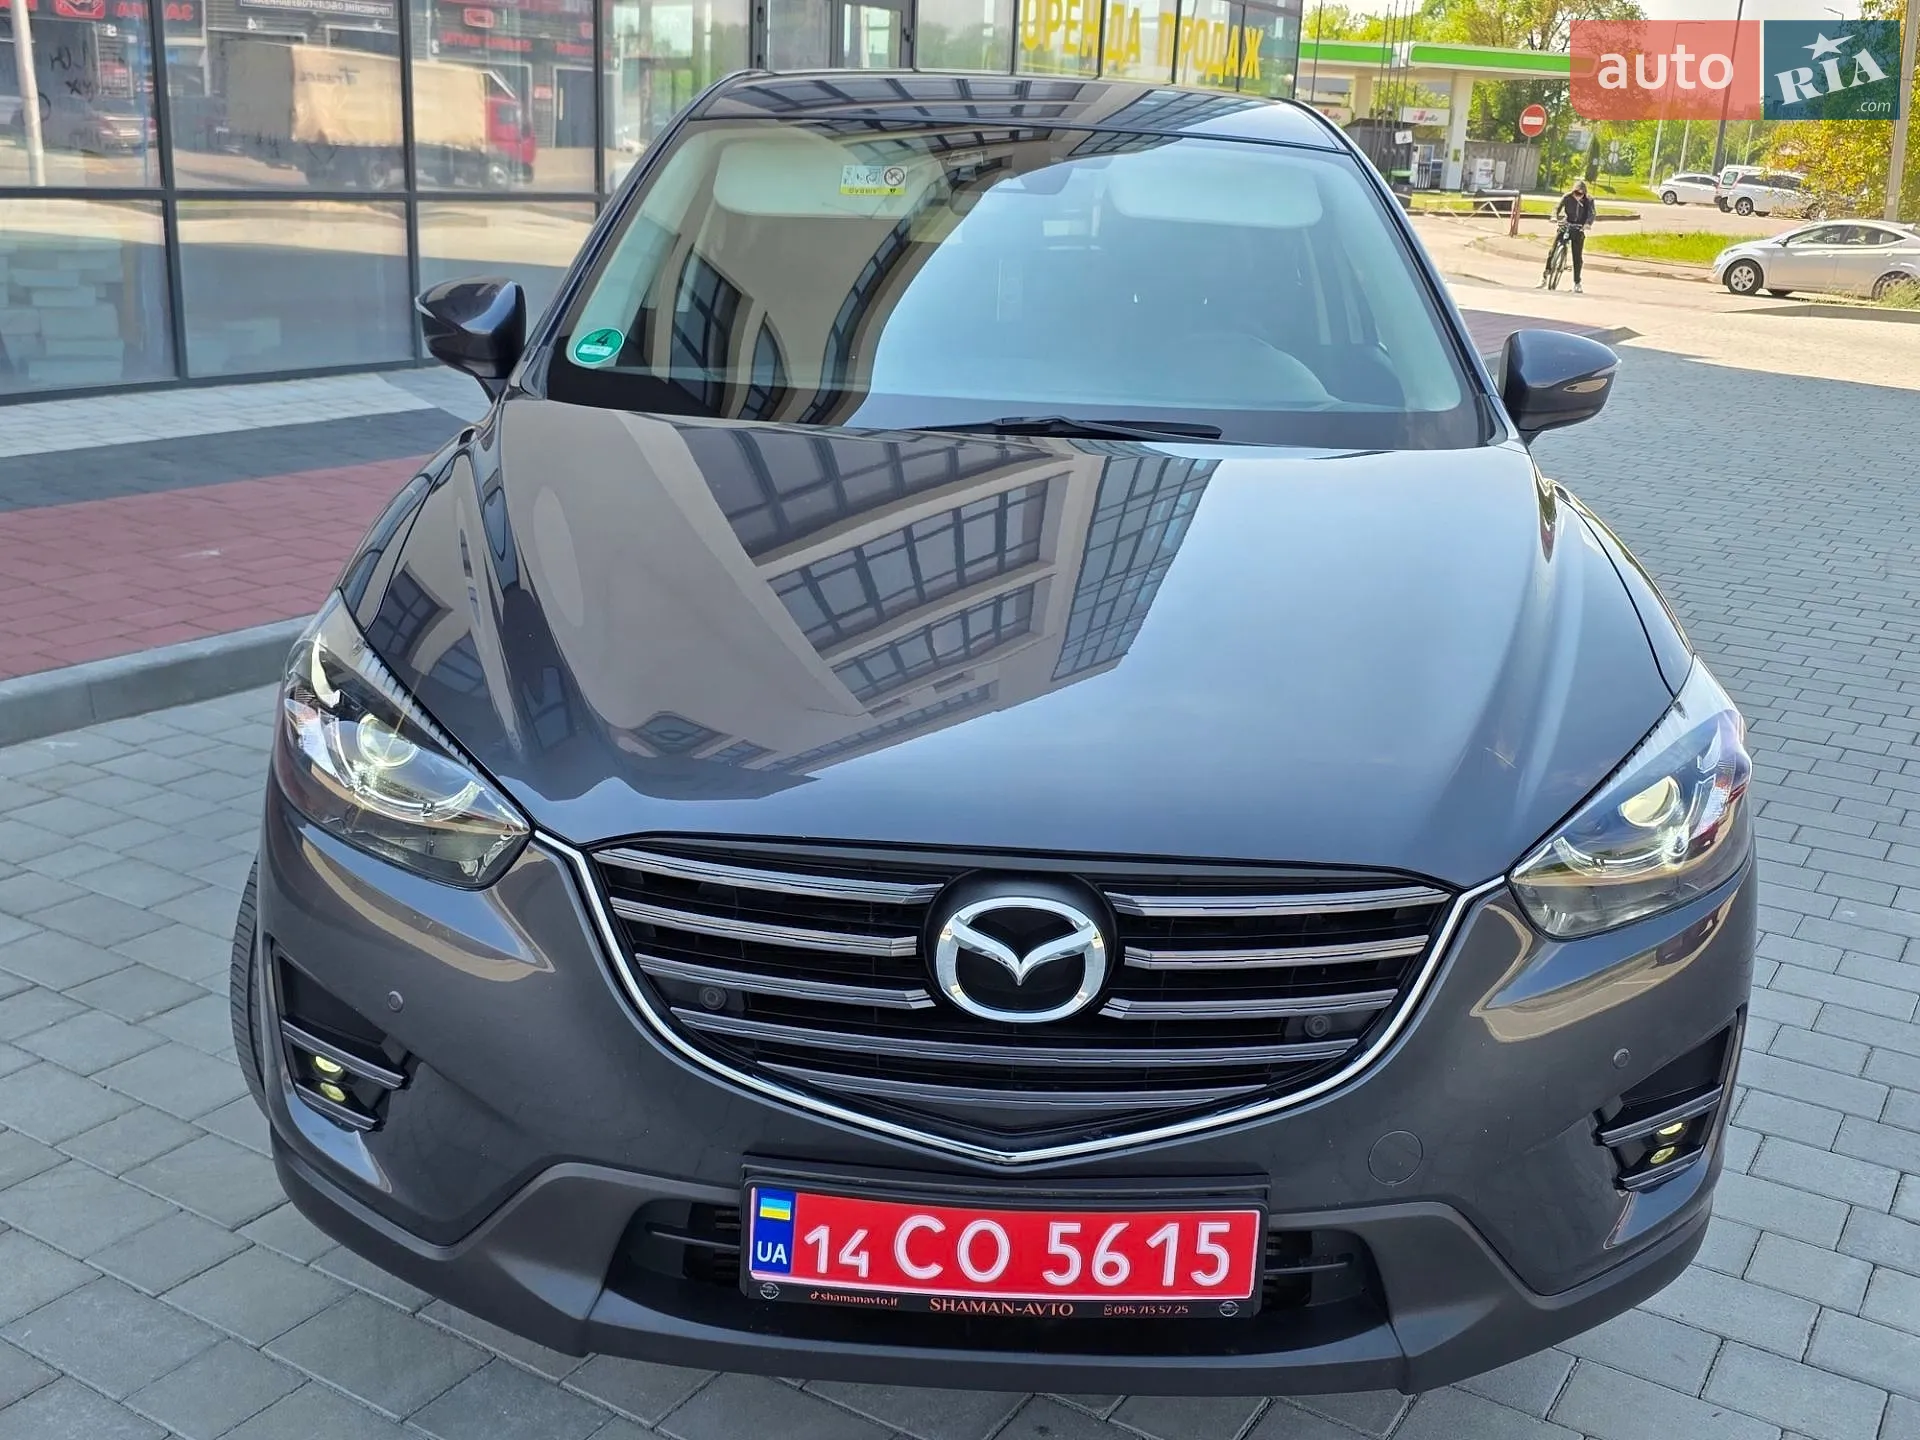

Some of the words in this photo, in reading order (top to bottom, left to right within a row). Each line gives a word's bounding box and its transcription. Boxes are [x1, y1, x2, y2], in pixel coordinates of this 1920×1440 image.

[1158, 12, 1264, 84] ПРОДАЖ
[595, 329, 612, 346] 4
[756, 1240, 788, 1265] UA
[803, 1223, 870, 1279] 14
[893, 1213, 1011, 1283] CO
[1042, 1221, 1231, 1287] 5615
[928, 1297, 1074, 1317] SHAMAN-AVTO
[1113, 1304, 1136, 1315] 095
[1174, 1304, 1189, 1315] 25
